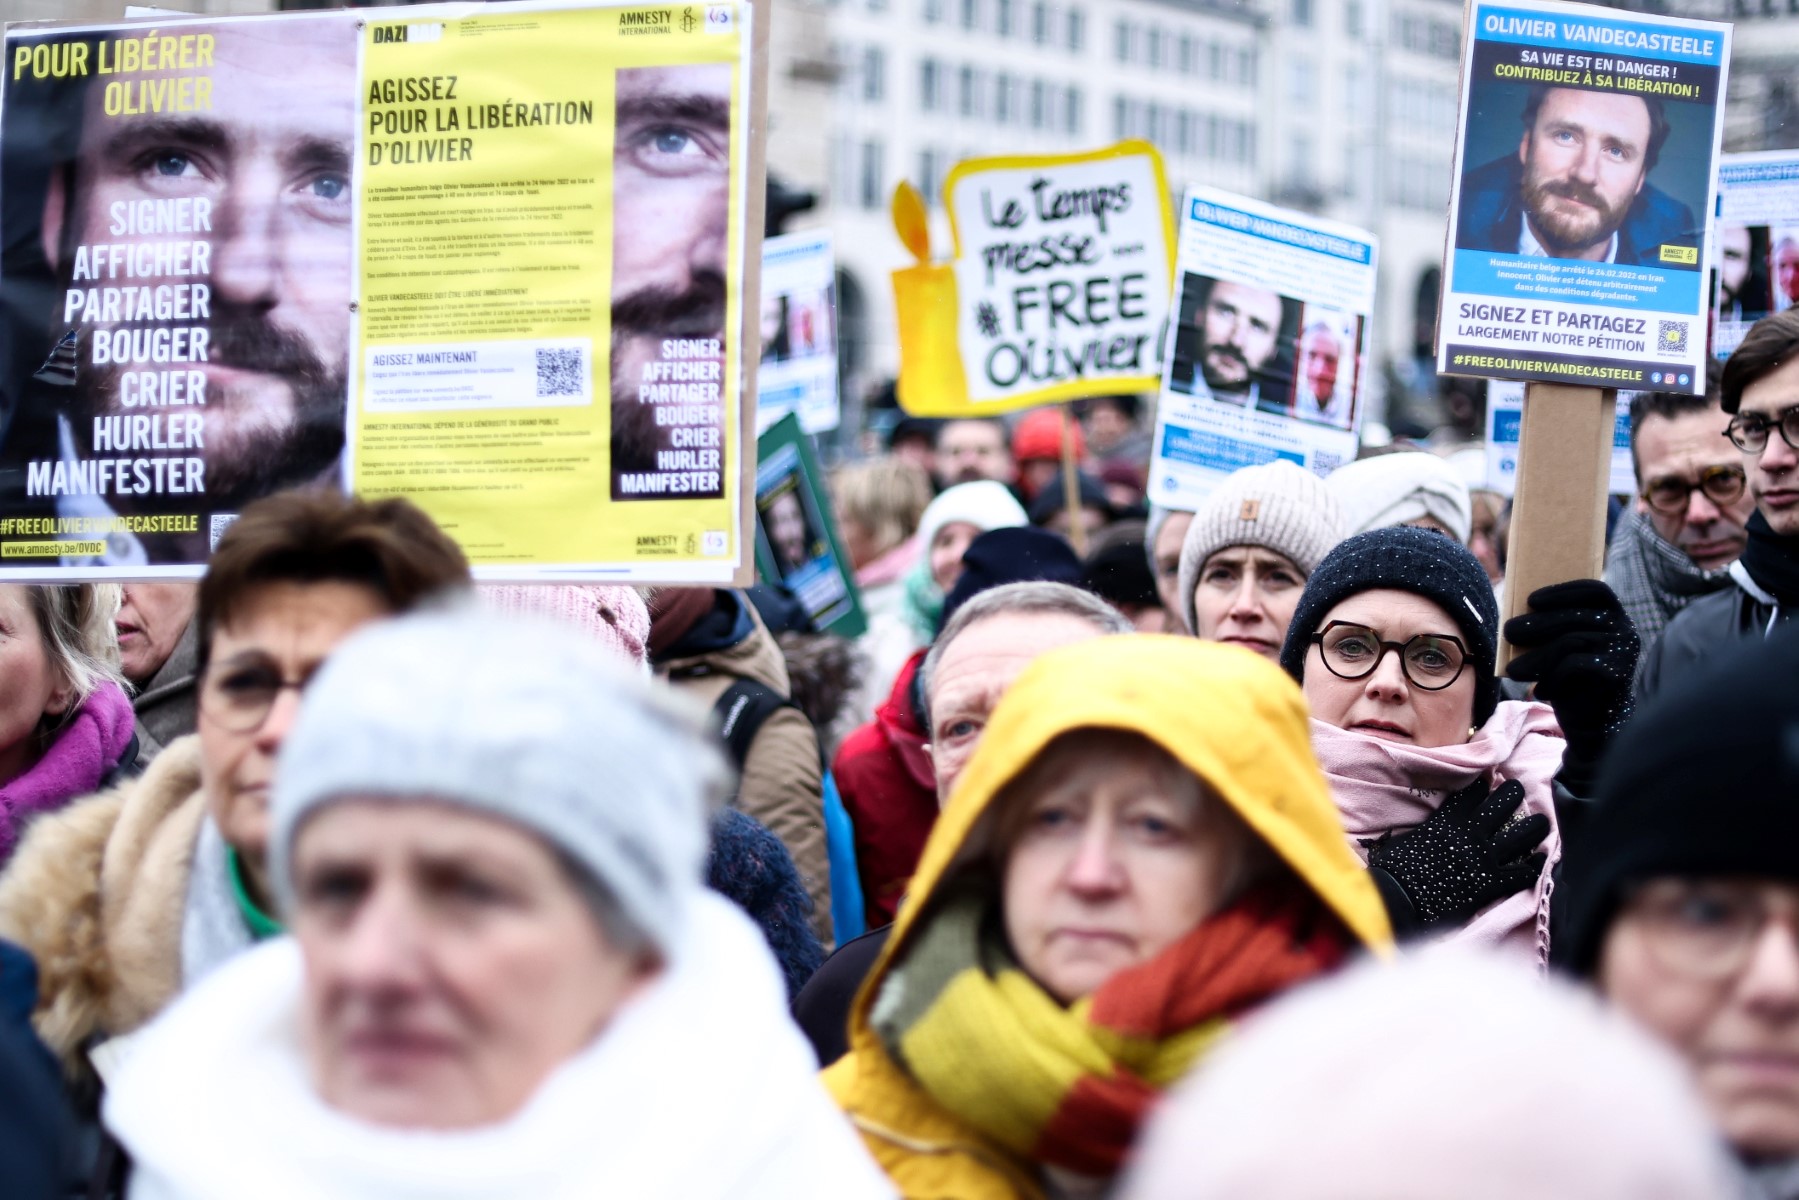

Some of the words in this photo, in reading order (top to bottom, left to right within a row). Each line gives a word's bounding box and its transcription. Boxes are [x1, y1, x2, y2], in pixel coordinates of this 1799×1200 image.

[618, 26, 671, 36] INTERNATIONAL
[620, 10, 672, 25] AMNESTY
[1485, 15, 1556, 40] OLIVIER
[1563, 24, 1714, 56] VANDECASTEELE
[14, 42, 88, 79] POUR
[98, 30, 214, 74] LIBÉRER
[1521, 50, 1539, 65] SA
[1542, 52, 1563, 66] VIE
[1567, 55, 1590, 70] EST
[1596, 58, 1612, 71] EN
[1616, 60, 1670, 78] DANGER
[368, 76, 458, 104] AGISSEZ
[1495, 64, 1580, 84] CONTRIBUEZ
[1583, 69, 1592, 85] À
[1596, 74, 1613, 88] SA
[1617, 76, 1692, 96] LIBÉRATION
[104, 77, 212, 116] OLIVIER
[370, 108, 428, 135] POUR
[436, 106, 459, 132] LA
[467, 100, 593, 130] LIBÉRATION
[368, 138, 472, 166] D'OLIVIER
[110, 197, 212, 236] SIGNER
[1028, 175, 1131, 234] temps
[73, 241, 210, 280] AFFICHER
[1490, 258, 1538, 271] Humanitaire
[1540, 262, 1560, 274] belge
[1562, 264, 1585, 275] arrêté
[1587, 266, 1594, 275] le
[1596, 268, 1636, 280] 24.02.2022
[1638, 273, 1648, 281] en
[1648, 273, 1665, 283] Iran.
[1497, 270, 1534, 283] Innocent,
[1535, 273, 1561, 283] Olivier
[1563, 276, 1574, 284] est
[1576, 276, 1602, 287] détenu
[1602, 278, 1658, 293] arbitrairement
[1515, 282, 1533, 291] dans
[1535, 284, 1548, 293] des
[1550, 285, 1590, 297] conditions
[1591, 288, 1638, 302] dégradantes.
[64, 284, 209, 322] PARTAGER
[390, 292, 433, 301] VANDECASTEELE
[1460, 302, 1526, 324] SIGNEZ
[1531, 309, 1553, 326] ET
[1557, 311, 1645, 335] PARTAGEZ
[93, 328, 208, 364] BOUGER
[662, 339, 720, 359] SIGNER
[1458, 324, 1538, 342] LARGEMENT
[1542, 331, 1584, 346] NOTRE
[1588, 332, 1645, 352] PÉTITION
[372, 354, 413, 366] AGISSEZ
[416, 351, 478, 364] MAINTENANT
[643, 362, 720, 382] AFFICHER
[1454, 354, 1642, 381] #FREEOLIVIERVANDECASTEELE
[120, 370, 206, 407] CRIER
[639, 383, 719, 404] PARTAGER
[390, 422, 432, 430] INTERNATIONAL
[656, 406, 719, 426] BOUGER
[94, 414, 204, 450] HURLER
[672, 428, 720, 448] CRIER
[658, 450, 720, 470] HURLER
[28, 458, 204, 496] MANIFESTER
[621, 472, 719, 493] MANIFESTER
[0, 515, 198, 534] #FREEOLIVIERVANDECASTEELE
[5, 542, 102, 556] www.amnesty.be/OVDC
[636, 536, 678, 547] AMNESTY
